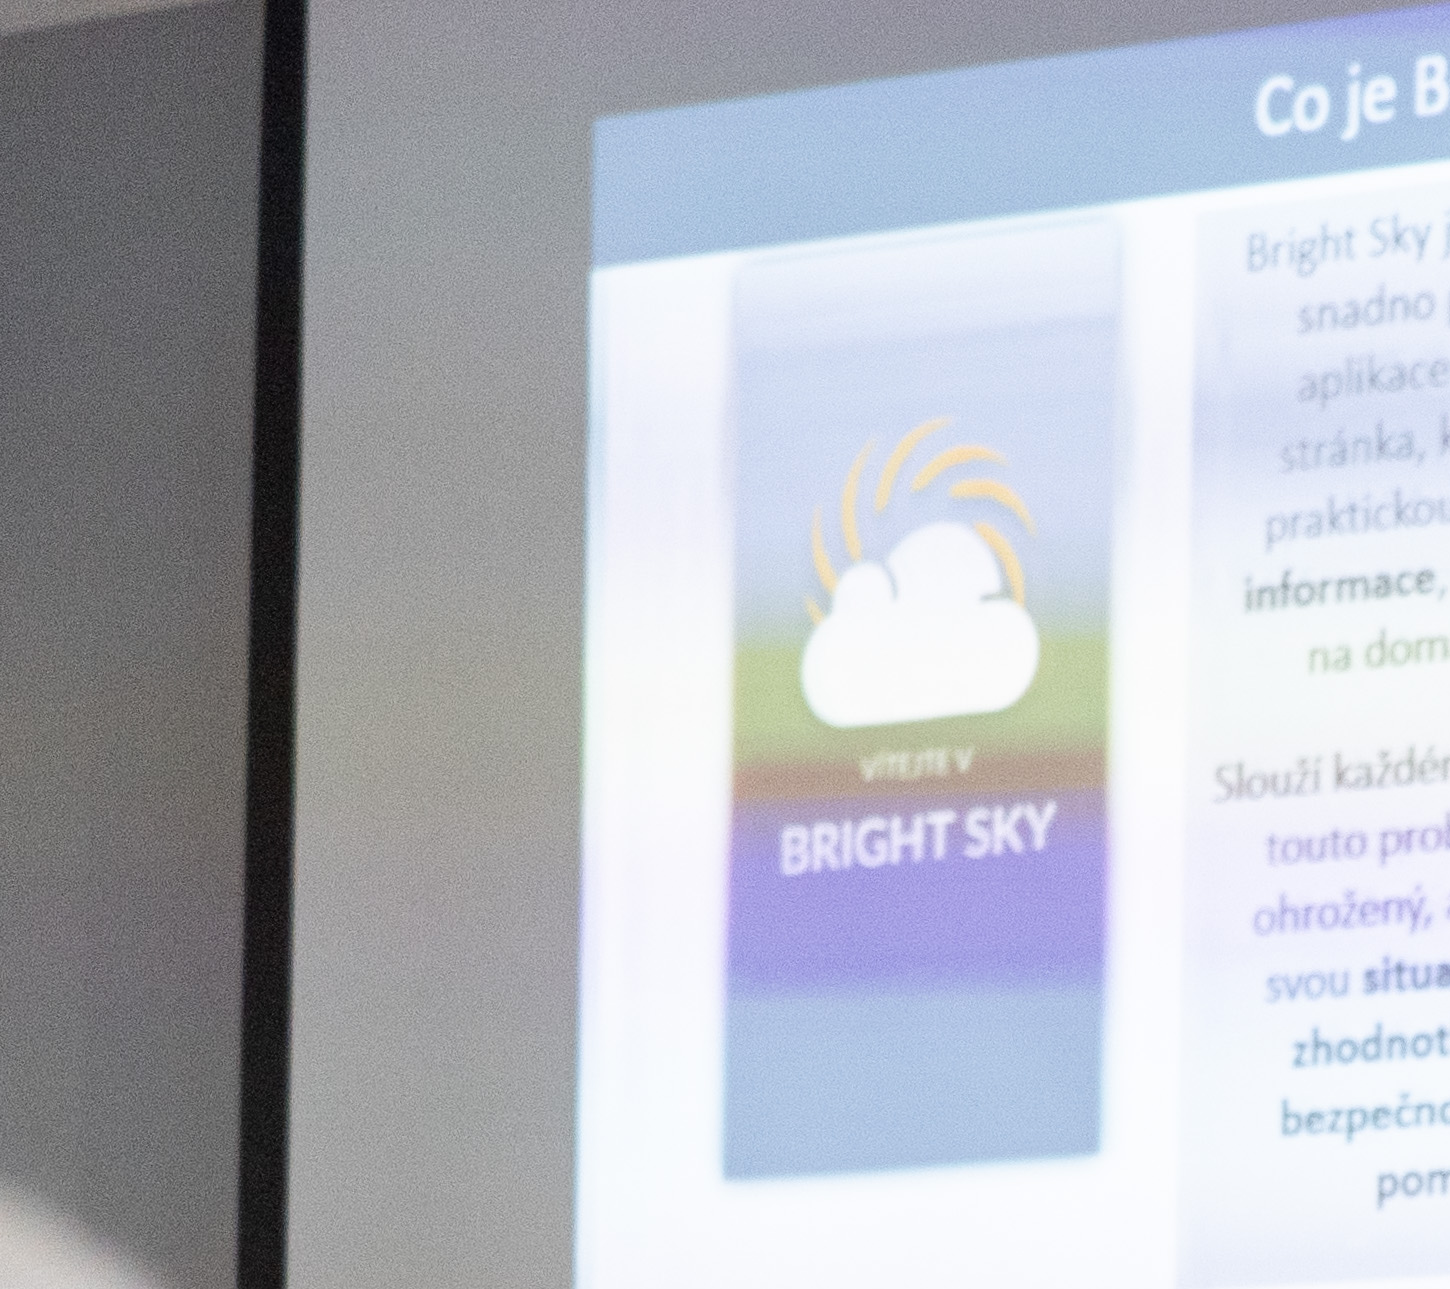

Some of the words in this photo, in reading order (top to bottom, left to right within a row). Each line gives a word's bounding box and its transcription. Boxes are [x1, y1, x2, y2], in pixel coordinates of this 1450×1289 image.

[1255, 73, 1328, 136] Co
[1342, 64, 1394, 140] je
[1247, 221, 1357, 277] Bright
[1370, 214, 1428, 260] Sky
[1298, 280, 1434, 334] snadno
[1298, 351, 1447, 408] aplikace
[1279, 422, 1423, 474] stránka,
[1244, 564, 1447, 611] informace,
[1308, 638, 1351, 674] na
[1212, 755, 1319, 801] Slouží
[780, 809, 957, 877] BRIGHT
[963, 800, 1058, 860] SKY
[1267, 826, 1366, 865] touto
[1253, 890, 1432, 936] ohrožený,
[1265, 968, 1348, 1002] svou
